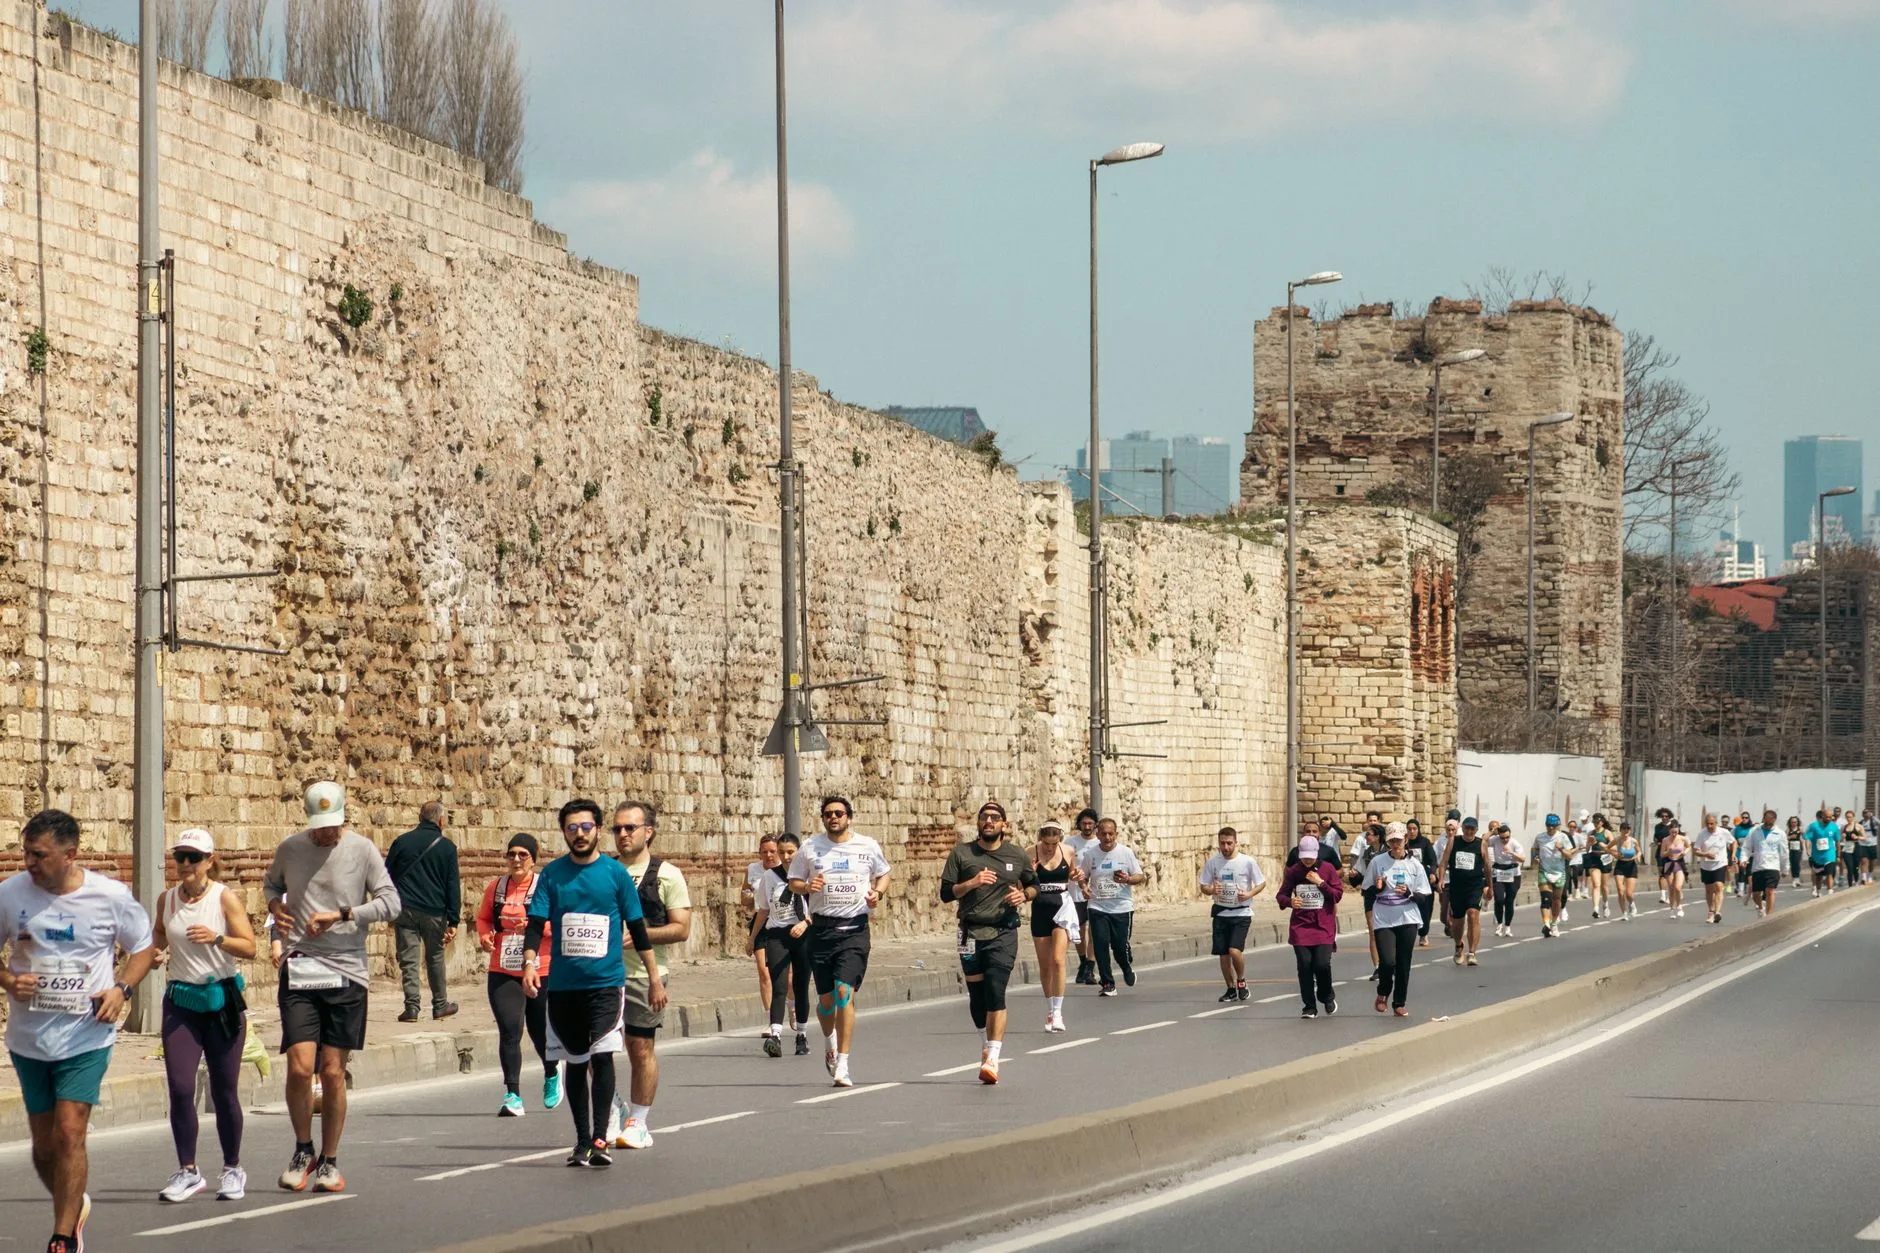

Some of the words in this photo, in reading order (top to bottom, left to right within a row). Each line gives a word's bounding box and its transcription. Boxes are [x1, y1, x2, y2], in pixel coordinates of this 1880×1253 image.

[827, 885, 833, 893] E
[834, 885, 857, 893] 4280
[566, 927, 575, 938] G
[577, 928, 604, 940] 5852
[504, 947, 512, 956] G
[513, 947, 524, 956] 63
[37, 976, 48, 989] G
[50, 978, 84, 990] 6392
